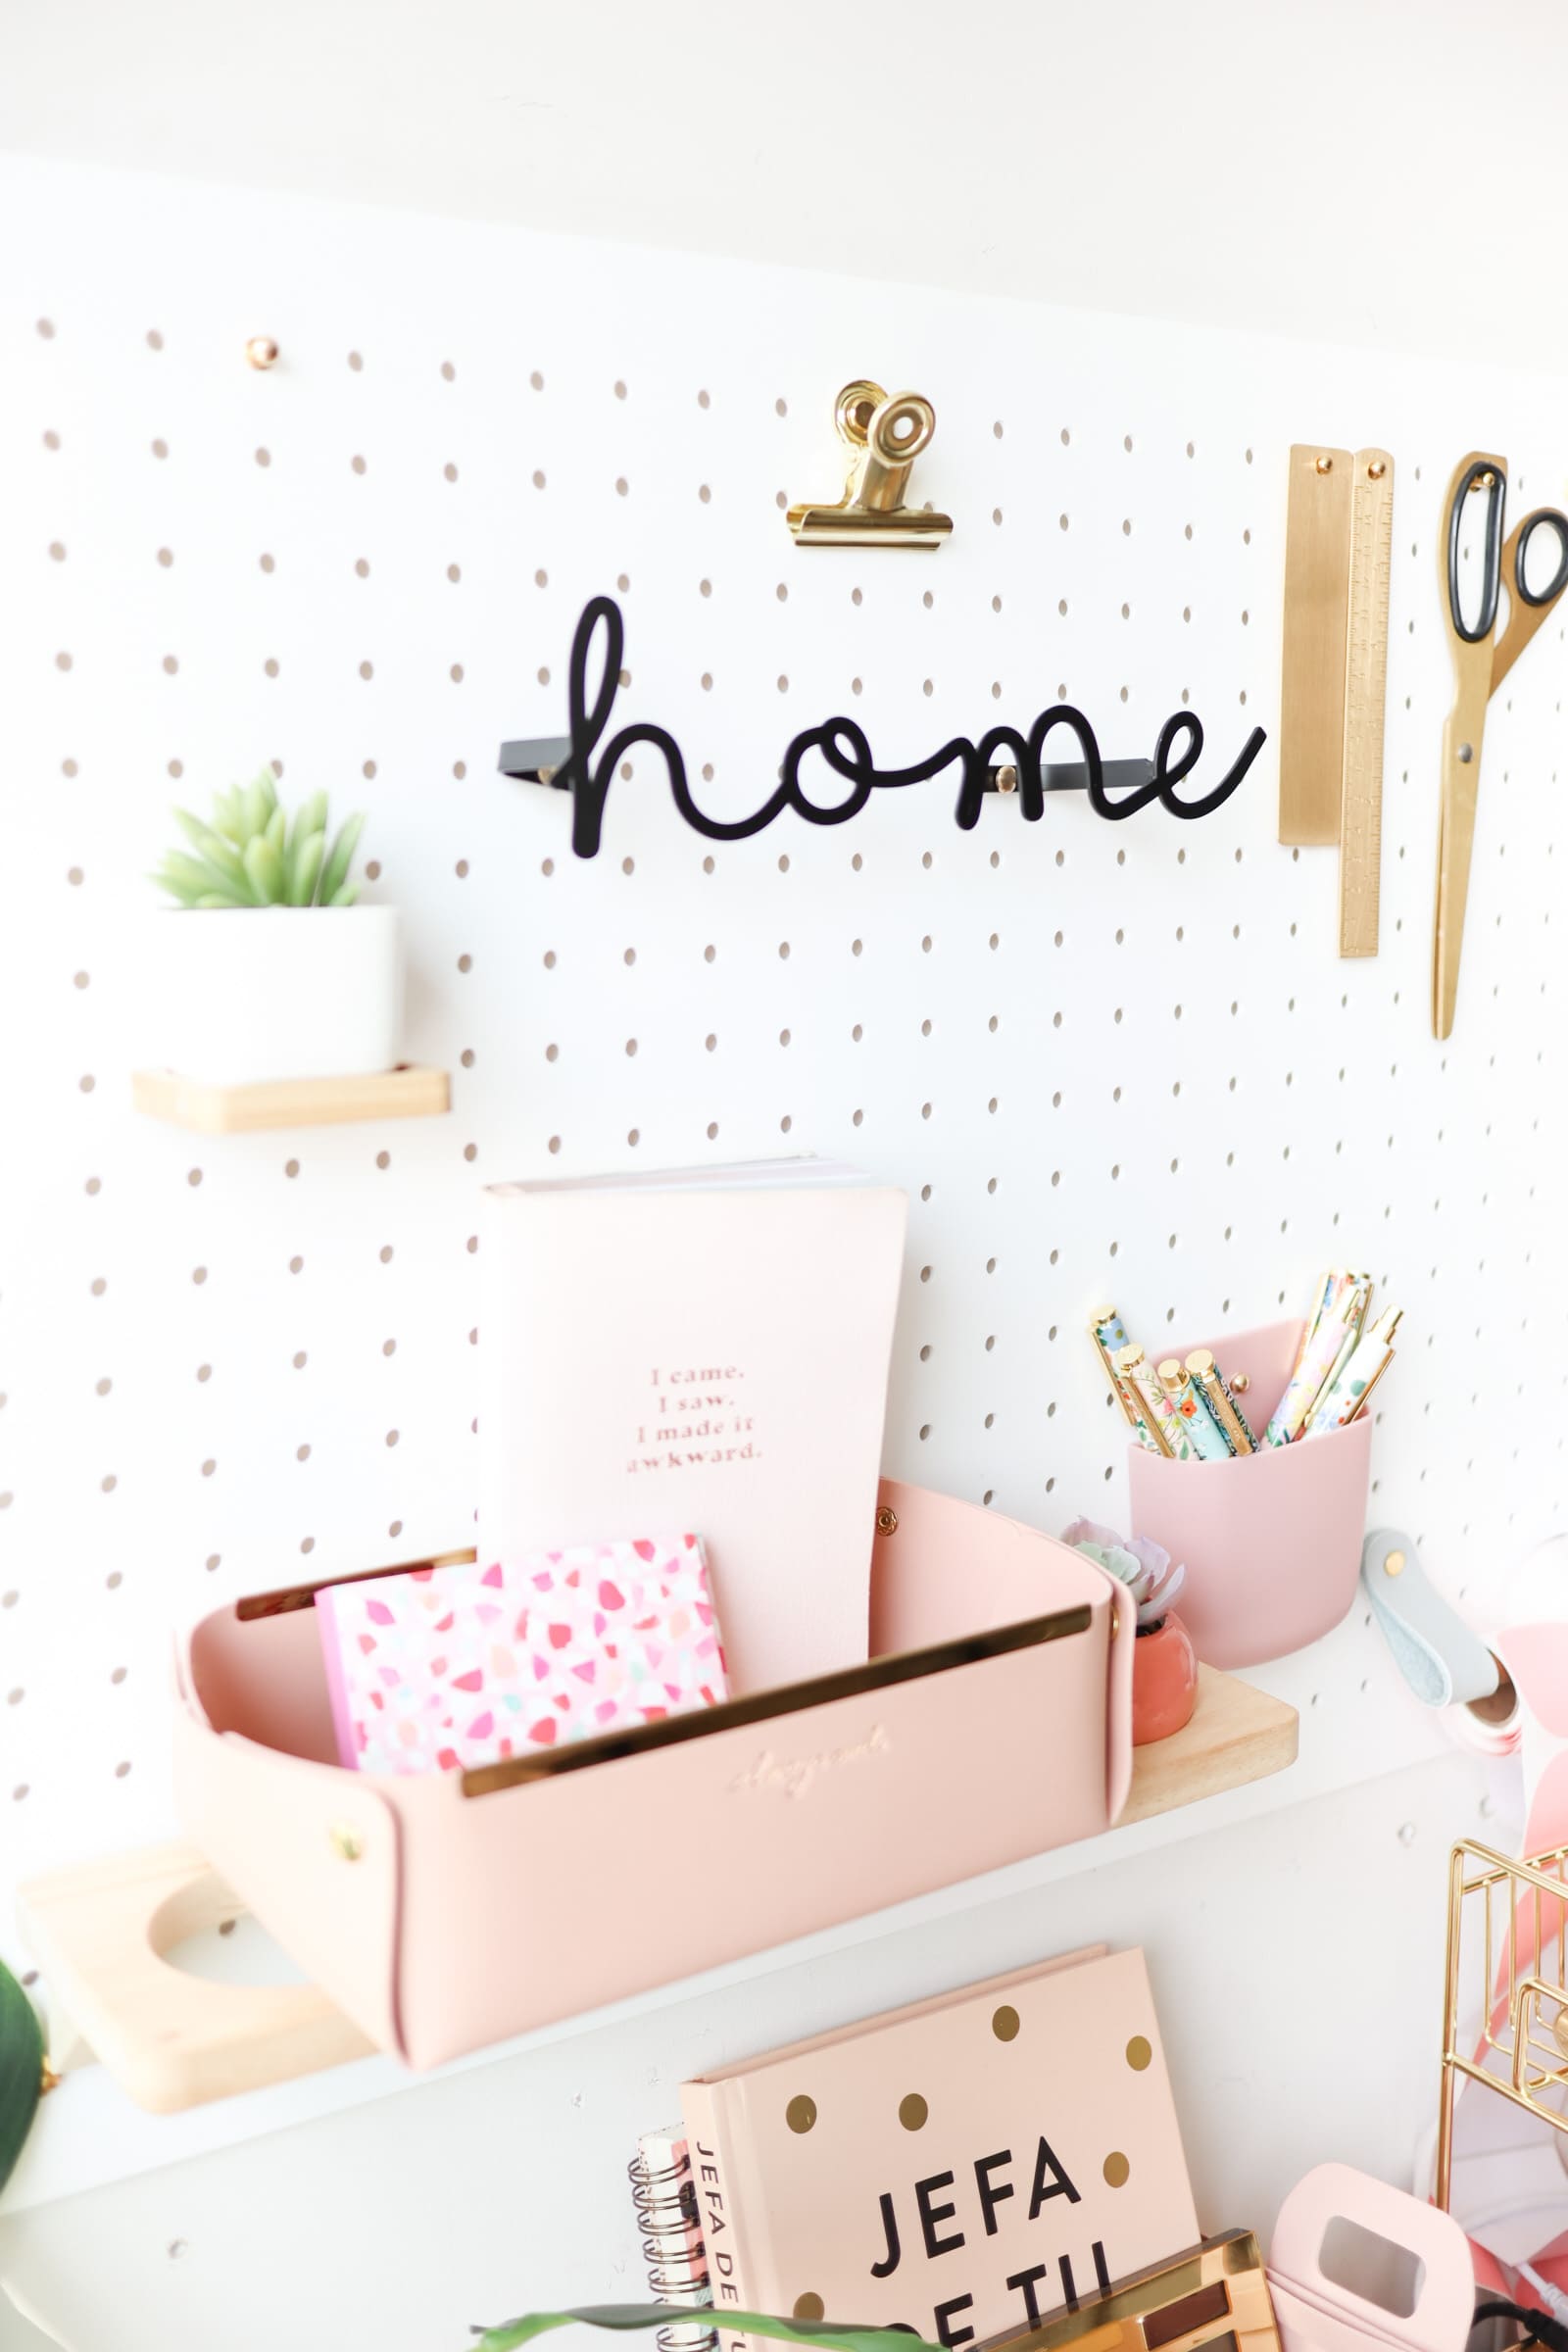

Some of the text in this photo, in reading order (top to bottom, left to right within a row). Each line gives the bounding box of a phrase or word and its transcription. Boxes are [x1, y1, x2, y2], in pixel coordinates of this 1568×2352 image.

[568, 596, 1267, 859] home
[652, 1365, 745, 1387] I came.
[660, 1395, 735, 1413] I saw.
[637, 1416, 754, 1444] I made it
[627, 1443, 762, 1473] awkward.
[870, 2135, 1082, 2278] JEFA
[696, 2141, 726, 2234] JEFA
[715, 2252, 739, 2303] DE
